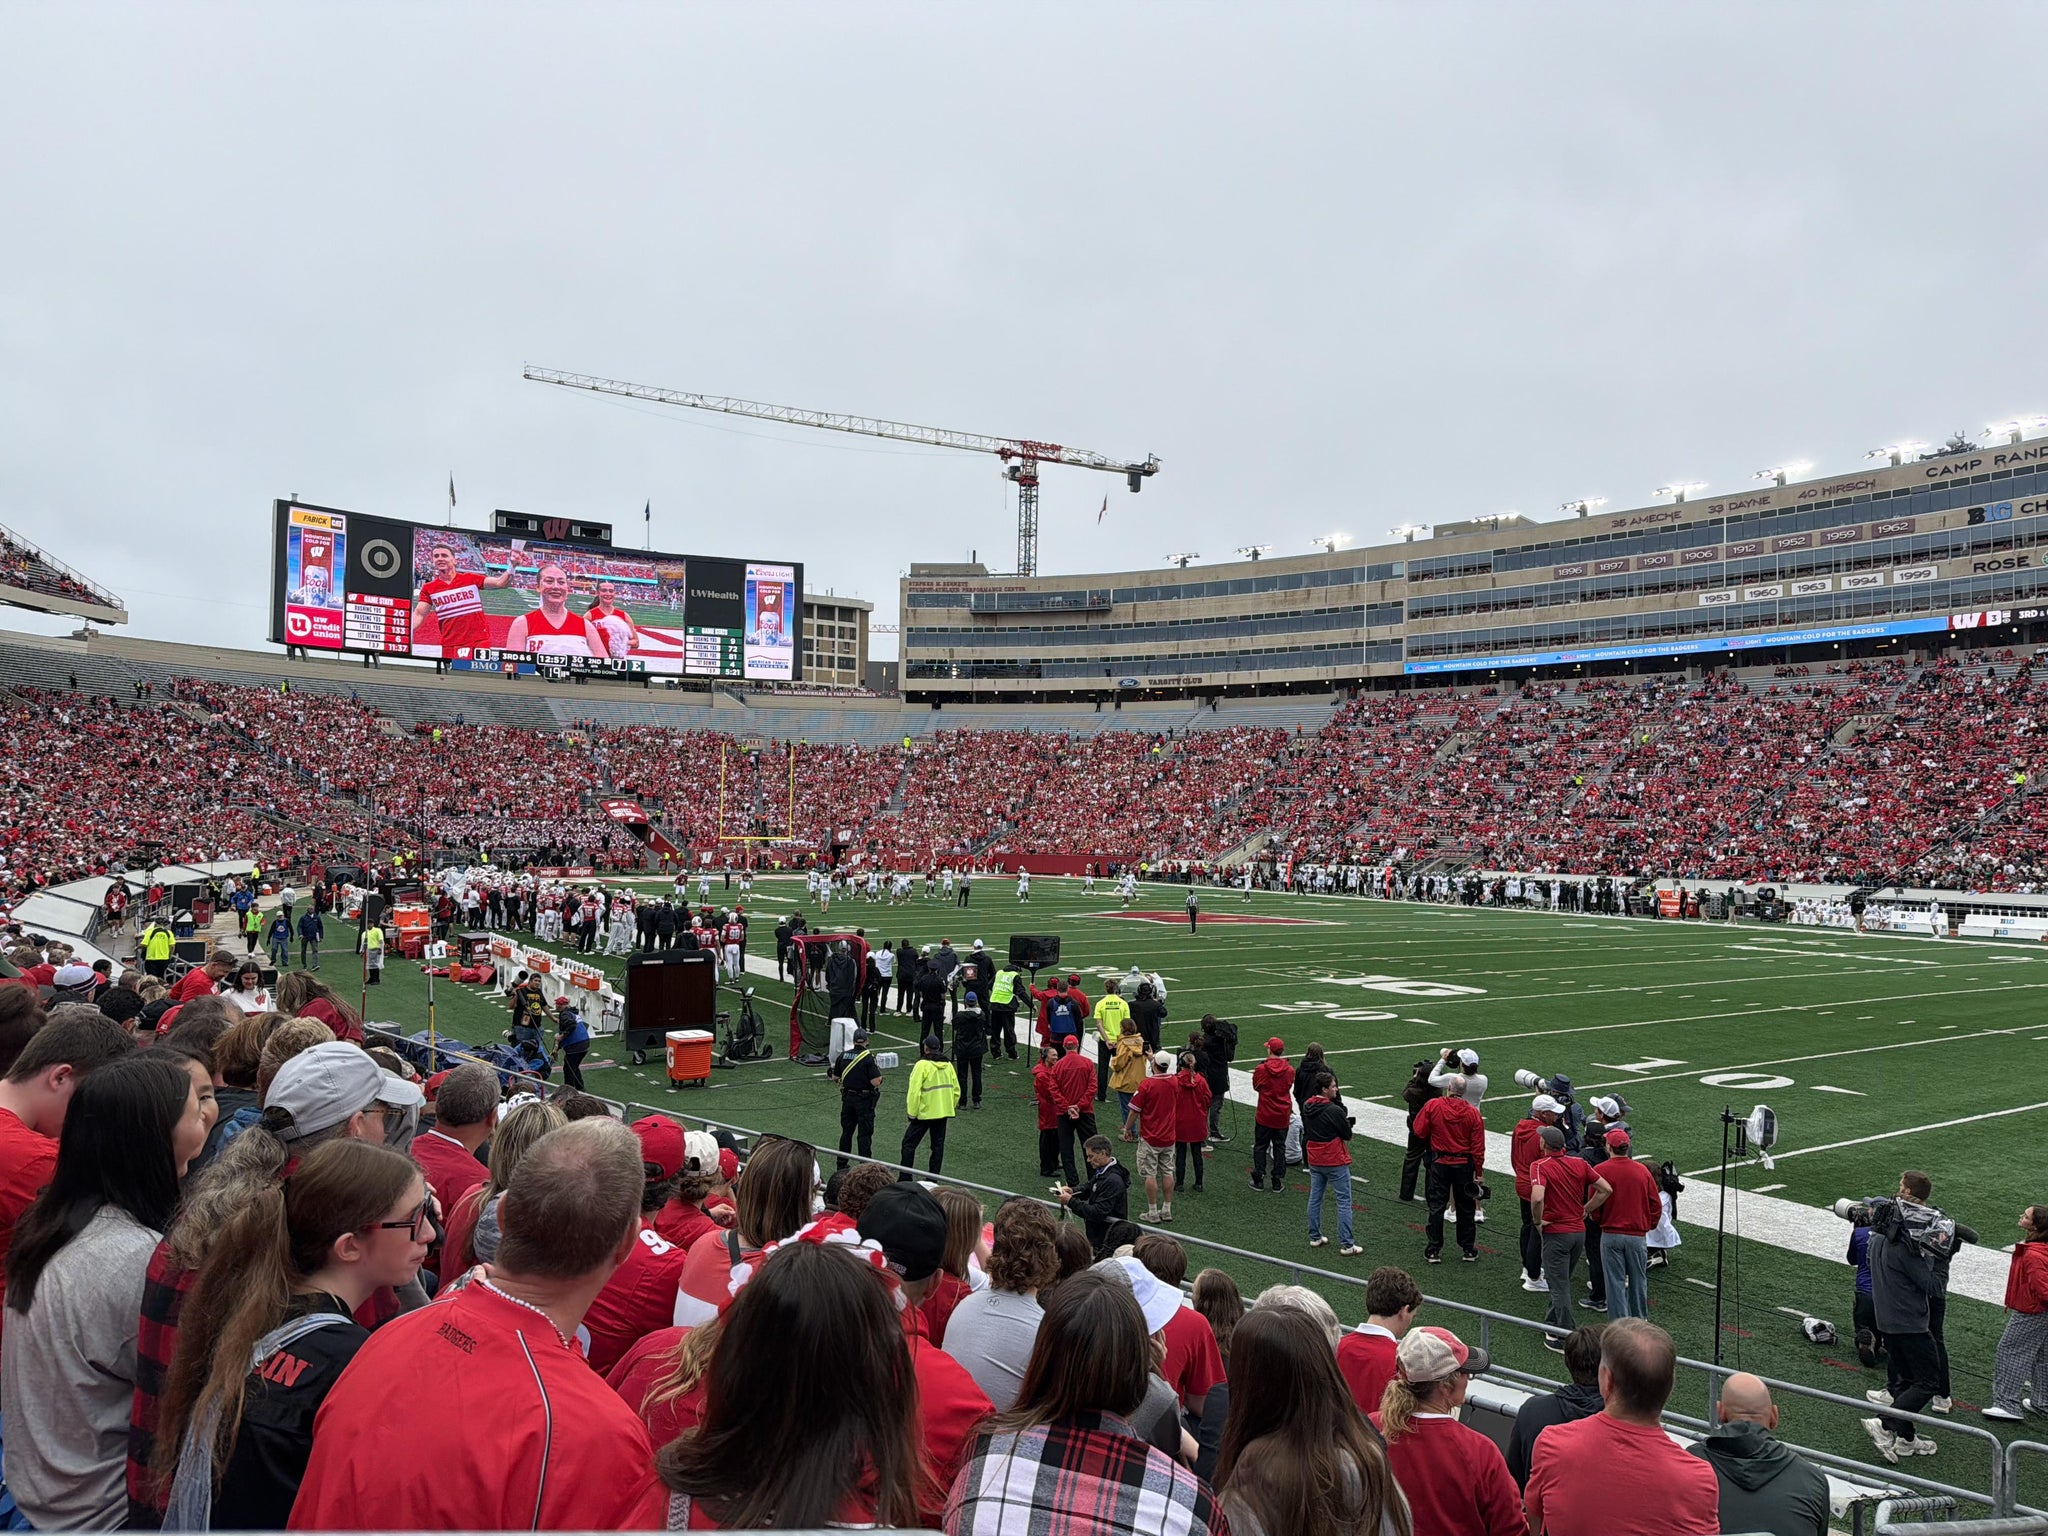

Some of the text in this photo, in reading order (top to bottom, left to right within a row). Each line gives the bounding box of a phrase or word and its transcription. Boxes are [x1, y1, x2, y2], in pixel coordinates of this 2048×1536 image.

[1925, 459, 1982, 478] CAMP
[1798, 479, 1876, 499] 40 HIRSCH
[1708, 496, 1771, 515] 33 DAYNE
[303, 515, 328, 525] FABICK
[1629, 510, 1682, 527] AMECHE
[1877, 522, 1909, 534] 1962
[304, 533, 331, 541] MOUNTAIN
[1826, 529, 1856, 541] 1959
[1777, 536, 1806, 548] 1952
[1732, 544, 1756, 554] 1912
[1643, 556, 1666, 565] 1901
[1685, 550, 1713, 561] 1906
[1599, 561, 1624, 571] 1897
[1973, 556, 2030, 573] ROSE
[1558, 566, 1583, 576] 1896
[1900, 569, 1931, 581] 1999
[1847, 576, 1878, 587] 1994
[1748, 588, 1778, 598] 1960
[1797, 582, 1826, 593] 1963
[432, 589, 475, 607] BADGERS
[1704, 593, 1731, 603] 1953
[2018, 610, 2038, 619] 3RD
[313, 623, 340, 632] credit
[392, 618, 405, 626] 113
[313, 630, 340, 639] union
[392, 627, 406, 635] 133
[1766, 635, 1800, 643] MOUNTAIN
[1802, 632, 1820, 640] COLD
[1852, 627, 1885, 635] BADGERS
[395, 635, 401, 643] 6
[389, 643, 408, 652] 11:37
[471, 661, 498, 670] BMO
[480, 650, 486, 659] 3
[540, 655, 565, 664] 12:57
[616, 660, 621, 669] 7
[632, 661, 641, 671] E
[549, 667, 560, 678] 19
[569, 867, 591, 877] meijer
[701, 934, 712, 945] 97
[666, 1046, 674, 1068] G
[435, 1322, 478, 1355] BADGERS
